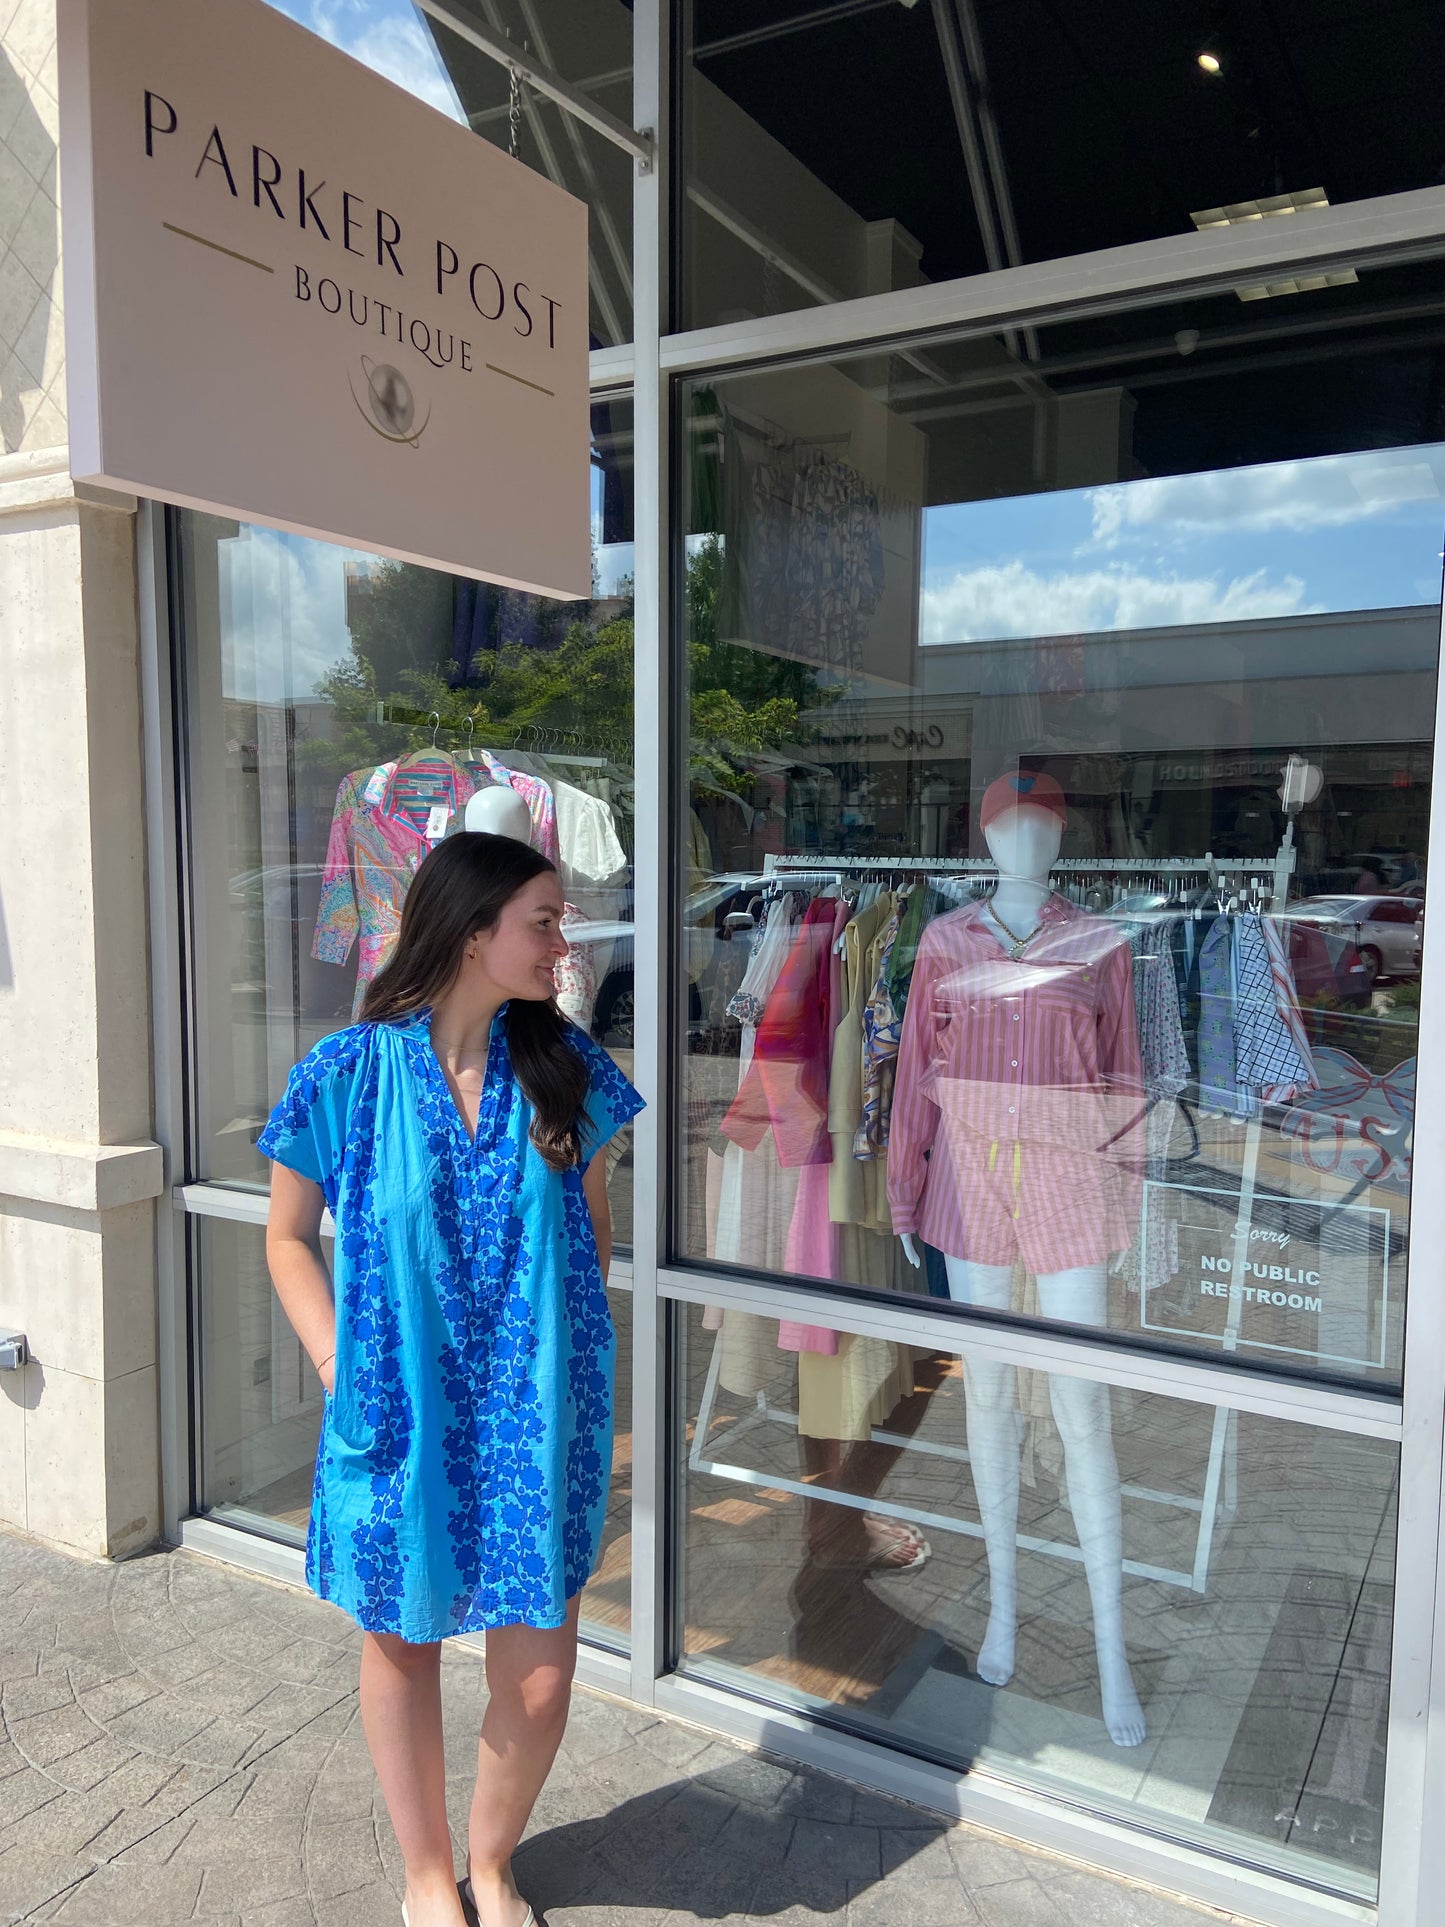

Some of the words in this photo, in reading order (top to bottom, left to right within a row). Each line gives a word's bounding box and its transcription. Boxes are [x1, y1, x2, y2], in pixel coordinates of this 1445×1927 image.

[143, 88, 404, 277] PARKER
[435, 240, 562, 349] POST
[294, 265, 473, 373] BOUTIQUE
[1293, 1112, 1412, 1181] US
[1230, 1221, 1290, 1250] Sorry
[1201, 1255, 1232, 1273] NO
[1239, 1261, 1320, 1286] PUBLIC
[1200, 1280, 1322, 1312] RESTROOM
